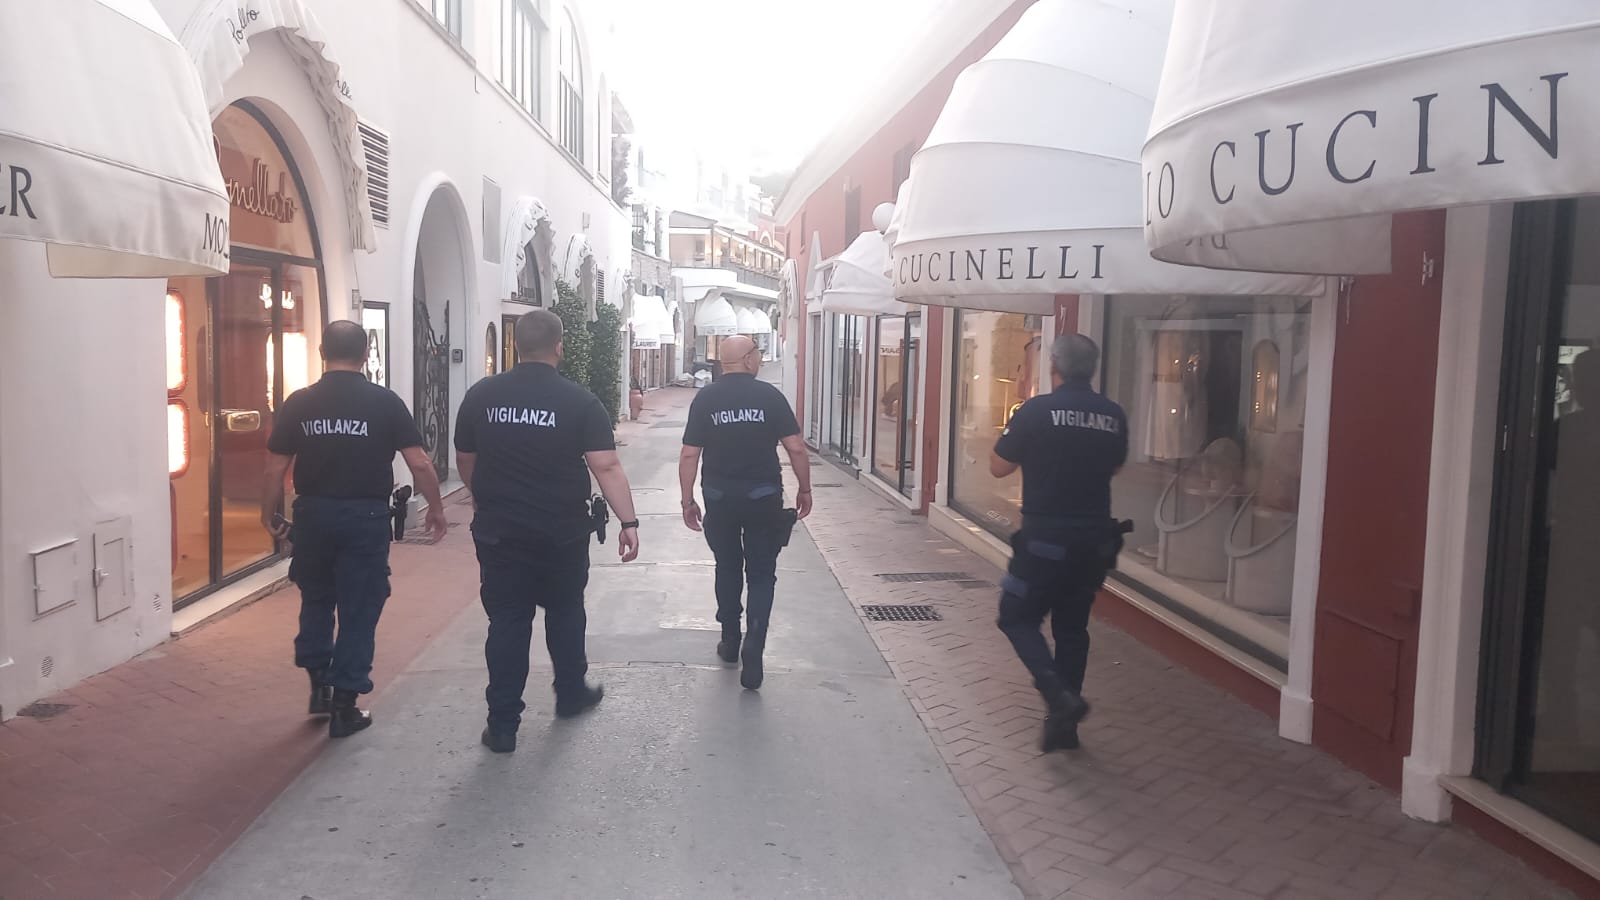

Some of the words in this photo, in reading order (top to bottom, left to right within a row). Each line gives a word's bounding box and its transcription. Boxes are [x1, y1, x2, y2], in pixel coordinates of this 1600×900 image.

[1209, 72, 1569, 205] CUCIN
[900, 244, 1105, 285] CUCINELLI
[486, 407, 556, 427] VIGILANZA
[711, 408, 765, 426] VIGILANZA
[301, 418, 368, 437] VIGILANZA
